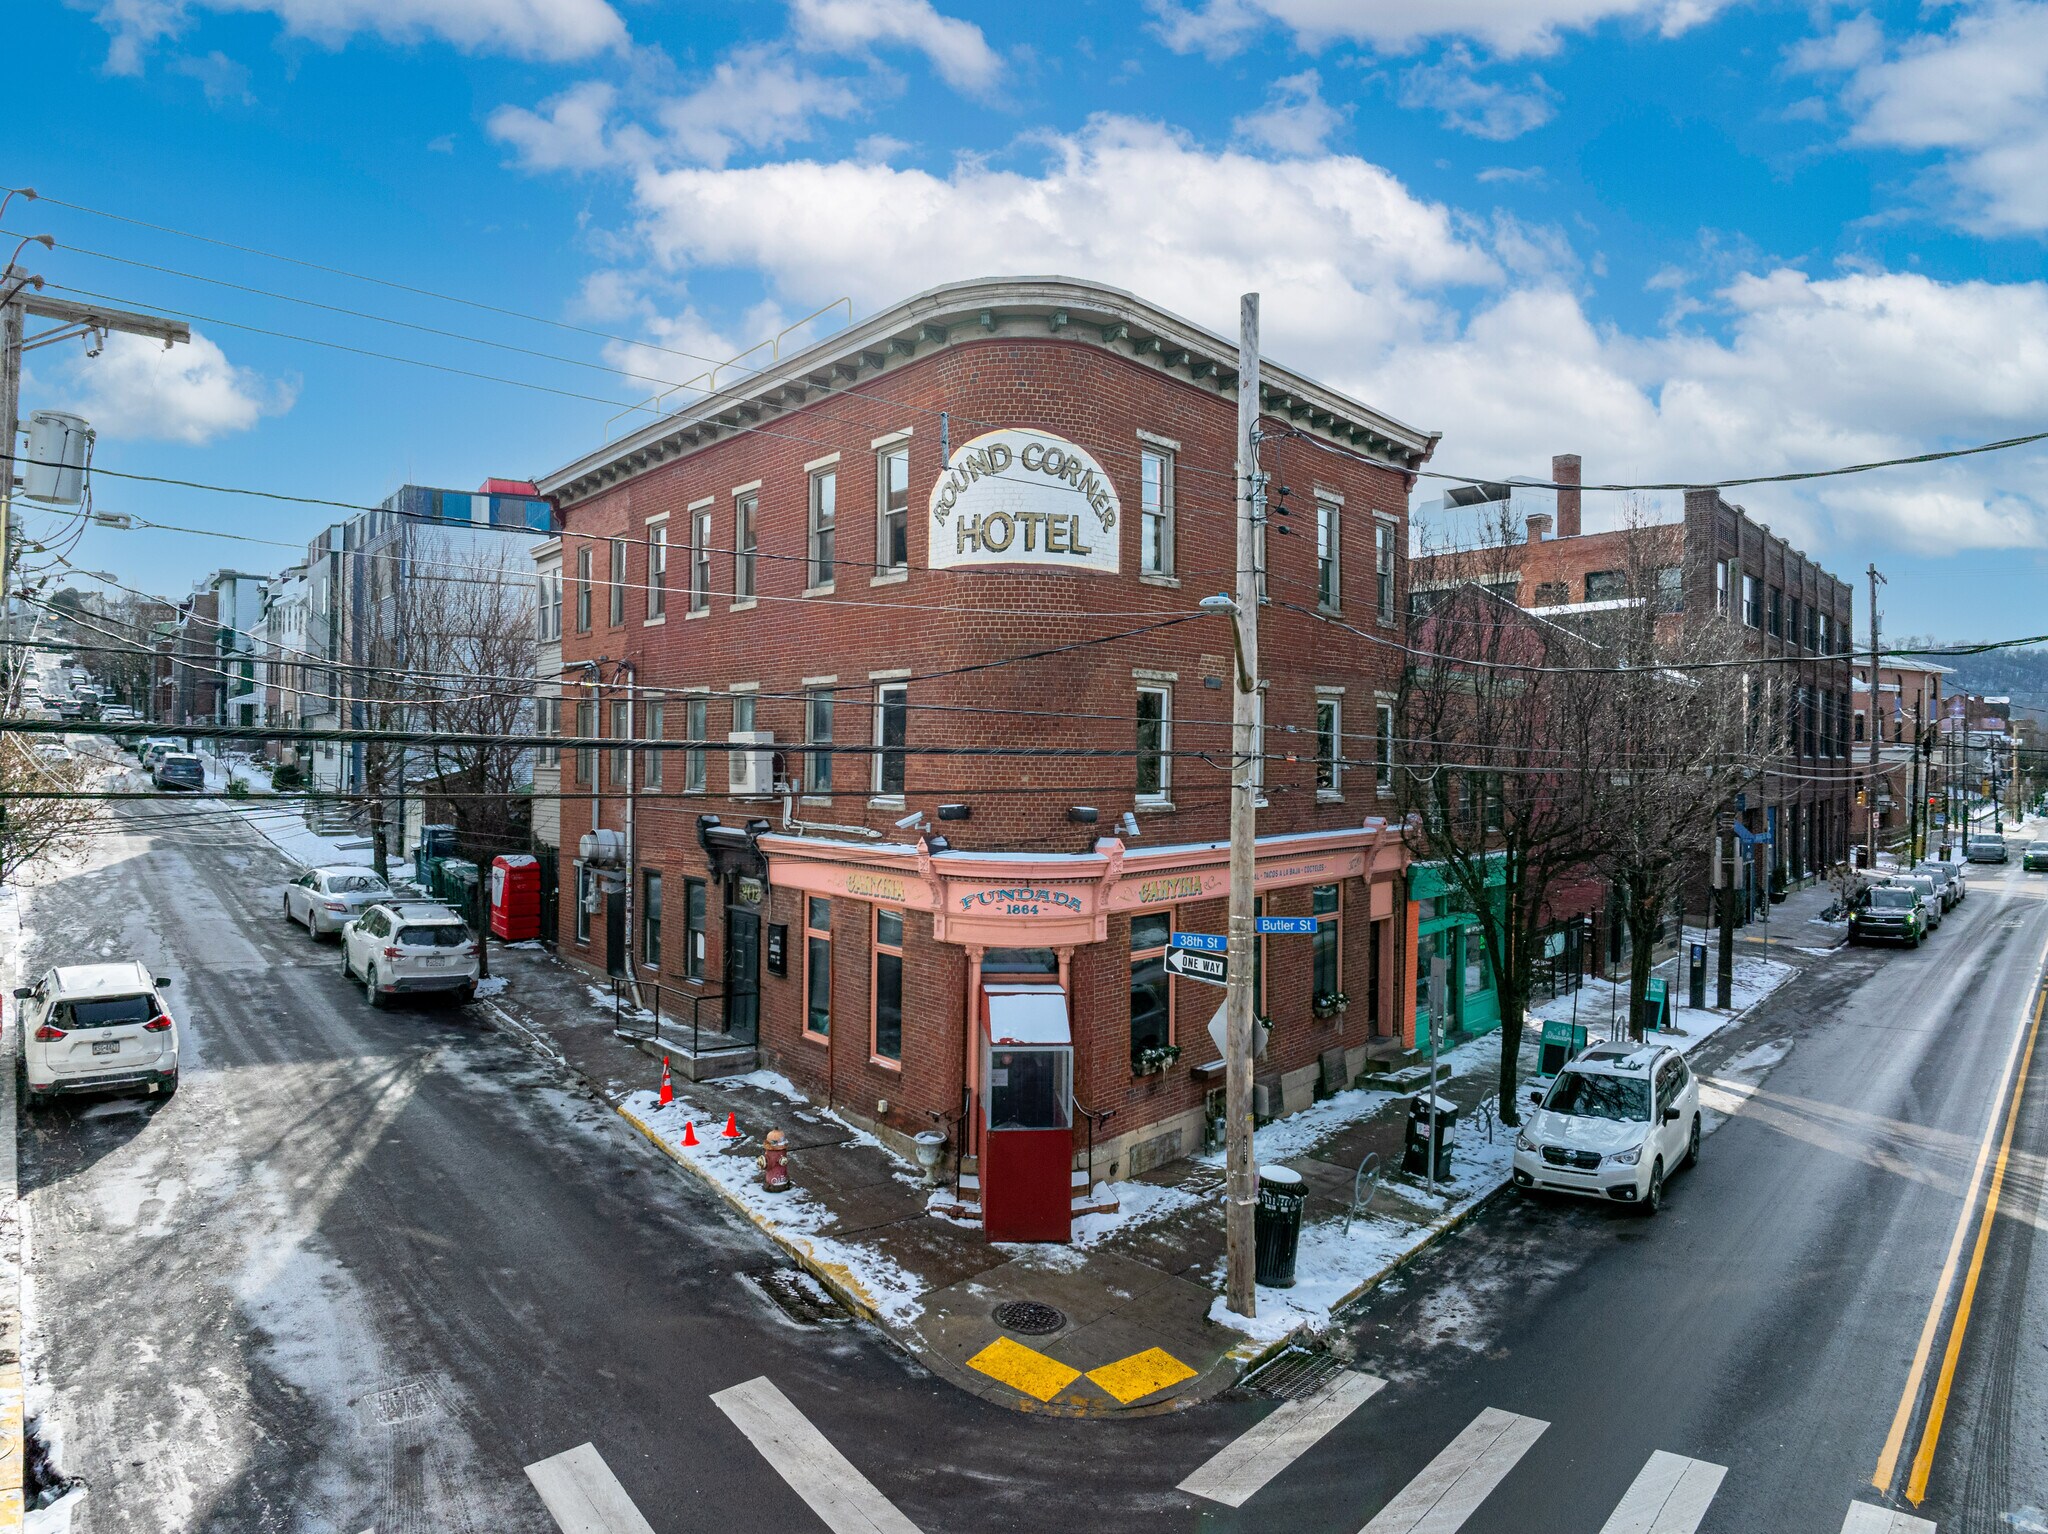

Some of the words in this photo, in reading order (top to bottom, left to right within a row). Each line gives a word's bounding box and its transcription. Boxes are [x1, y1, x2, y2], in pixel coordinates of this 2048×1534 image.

[933, 442, 1013, 527] ROUND
[1021, 442, 1117, 534] CORNER
[956, 511, 1092, 556] HOTEL
[960, 887, 1083, 913] FUNDADA
[1006, 904, 1039, 915] 1864
[1262, 919, 1294, 931] Butler
[1299, 919, 1311, 931] St
[1180, 935, 1203, 948] 38th
[1207, 937, 1218, 949] St
[1182, 956, 1198, 969] ONE
[1202, 960, 1221, 974] WAY
